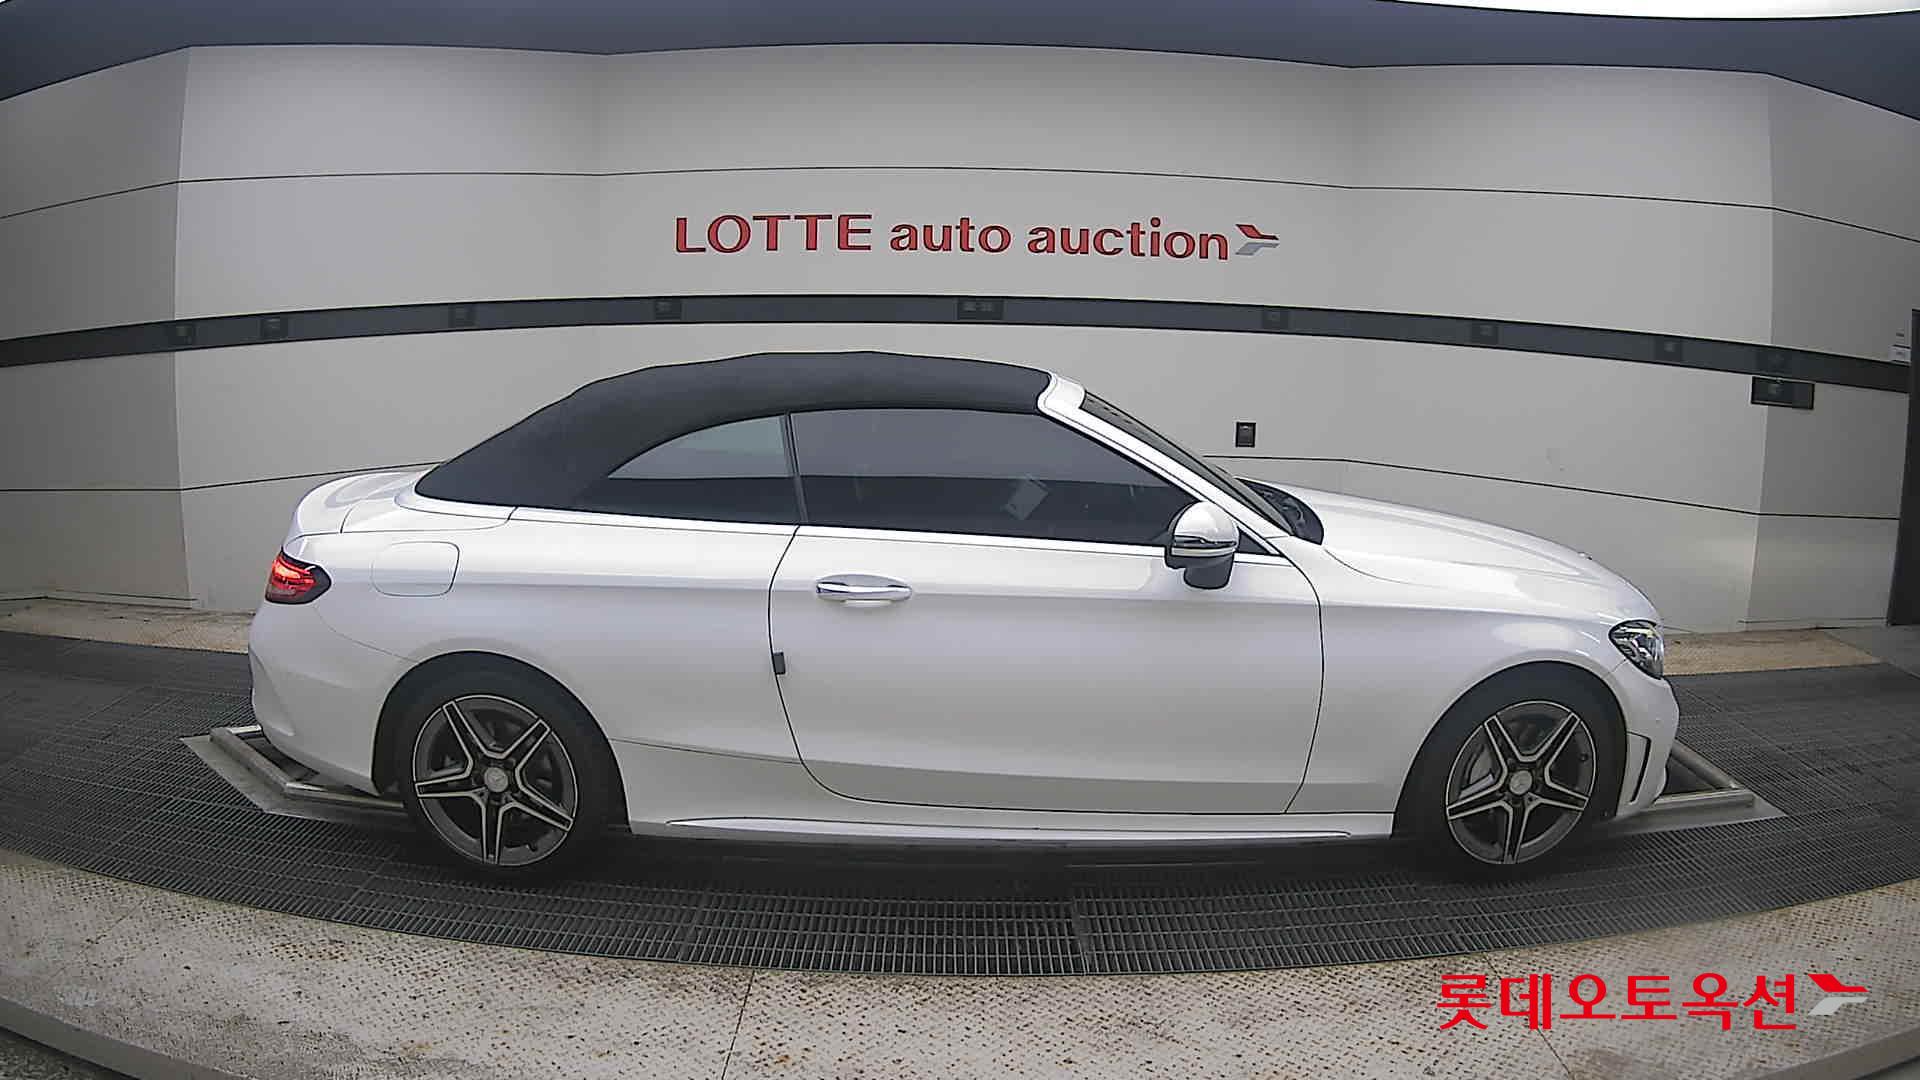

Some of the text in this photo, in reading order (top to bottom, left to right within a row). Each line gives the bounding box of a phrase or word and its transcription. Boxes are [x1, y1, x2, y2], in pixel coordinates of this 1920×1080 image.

[675, 214, 1230, 261] LOTTE auto auction
